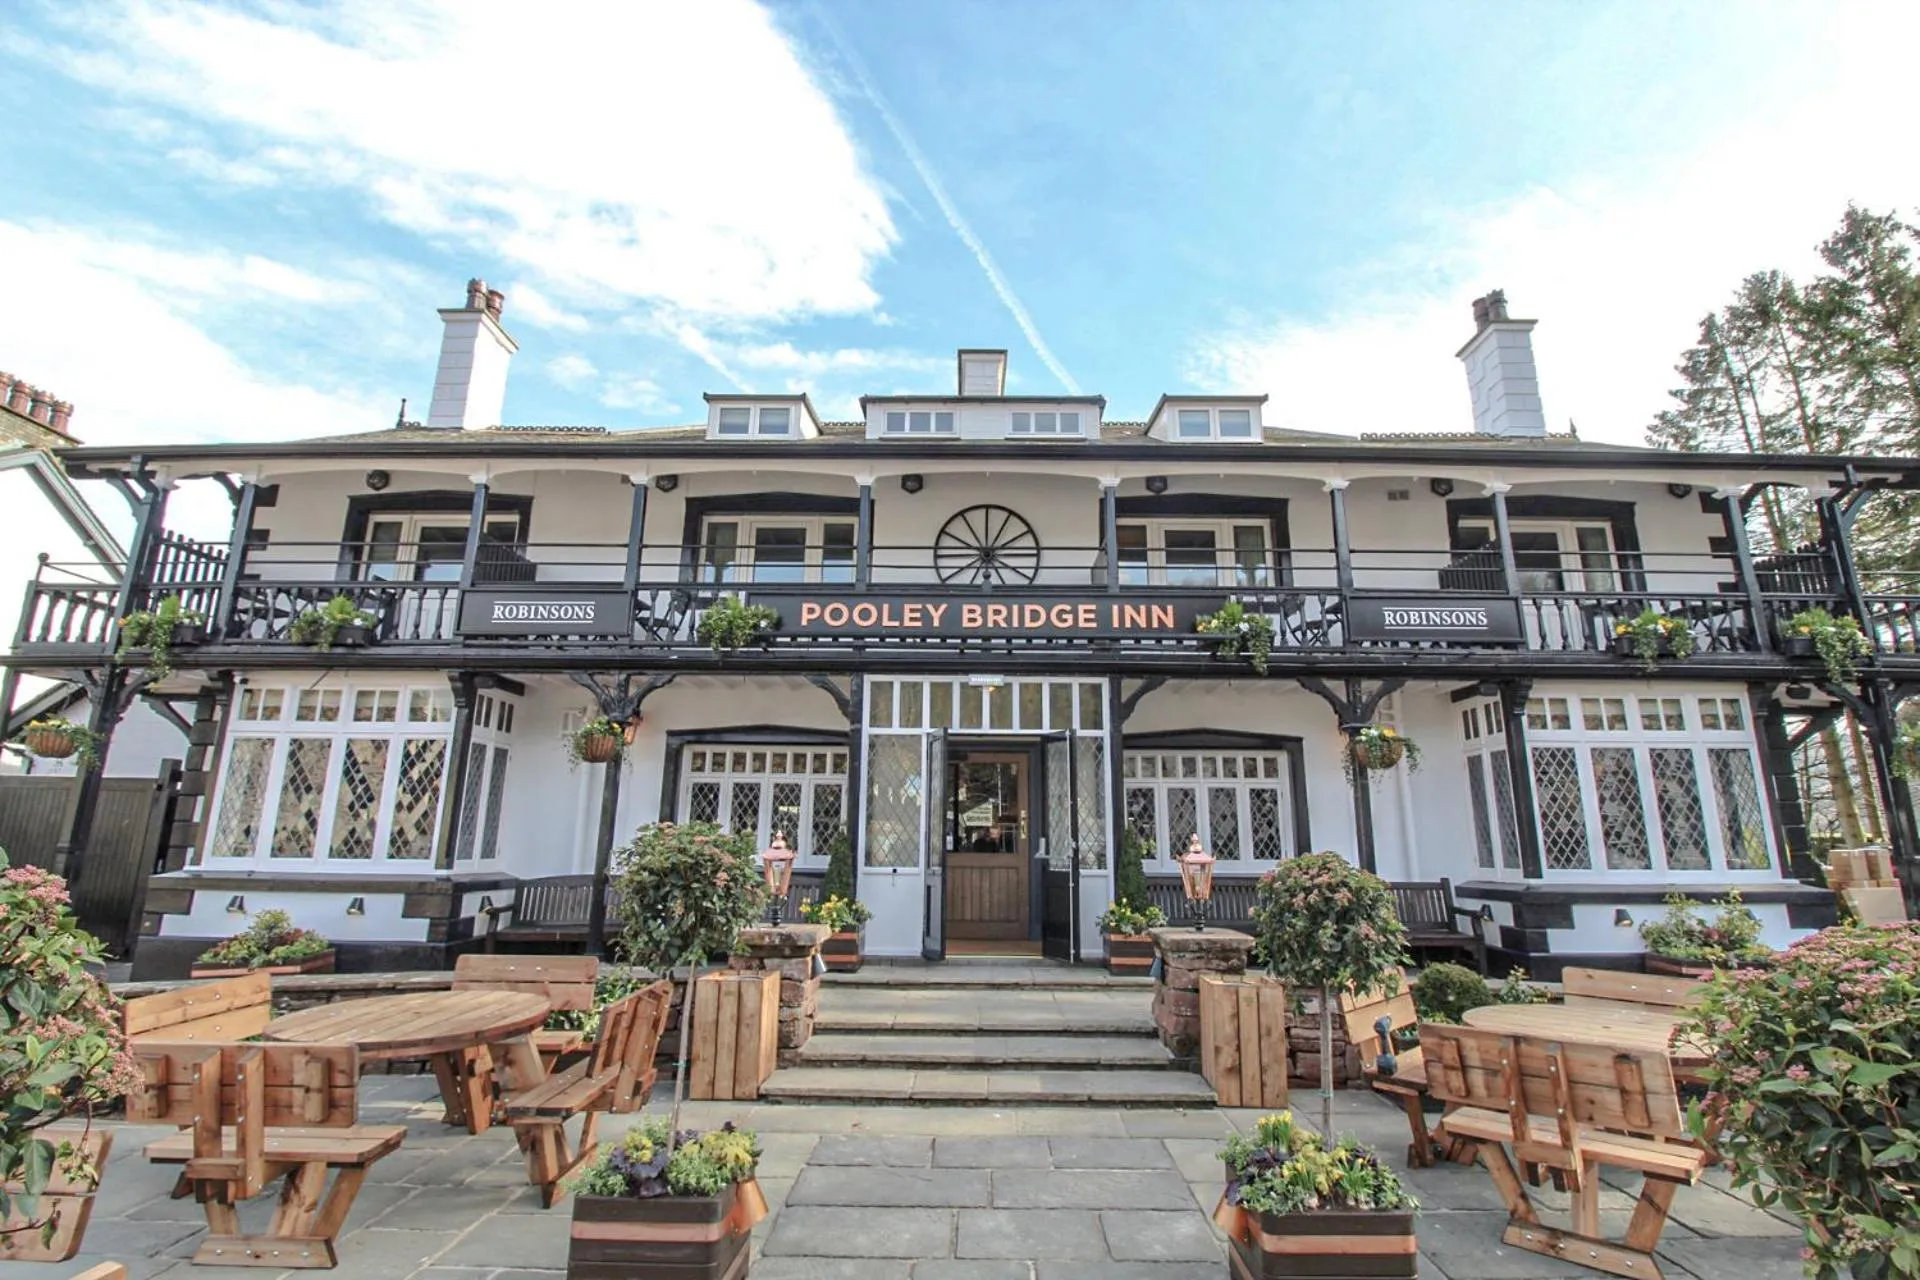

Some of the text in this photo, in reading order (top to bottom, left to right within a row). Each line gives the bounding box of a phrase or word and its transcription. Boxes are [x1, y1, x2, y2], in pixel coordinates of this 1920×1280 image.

[492, 604, 595, 619] ROBINSONS
[800, 602, 1175, 629] POOLEY BRIDGE INN
[1383, 611, 1488, 626] ROBINSONS
